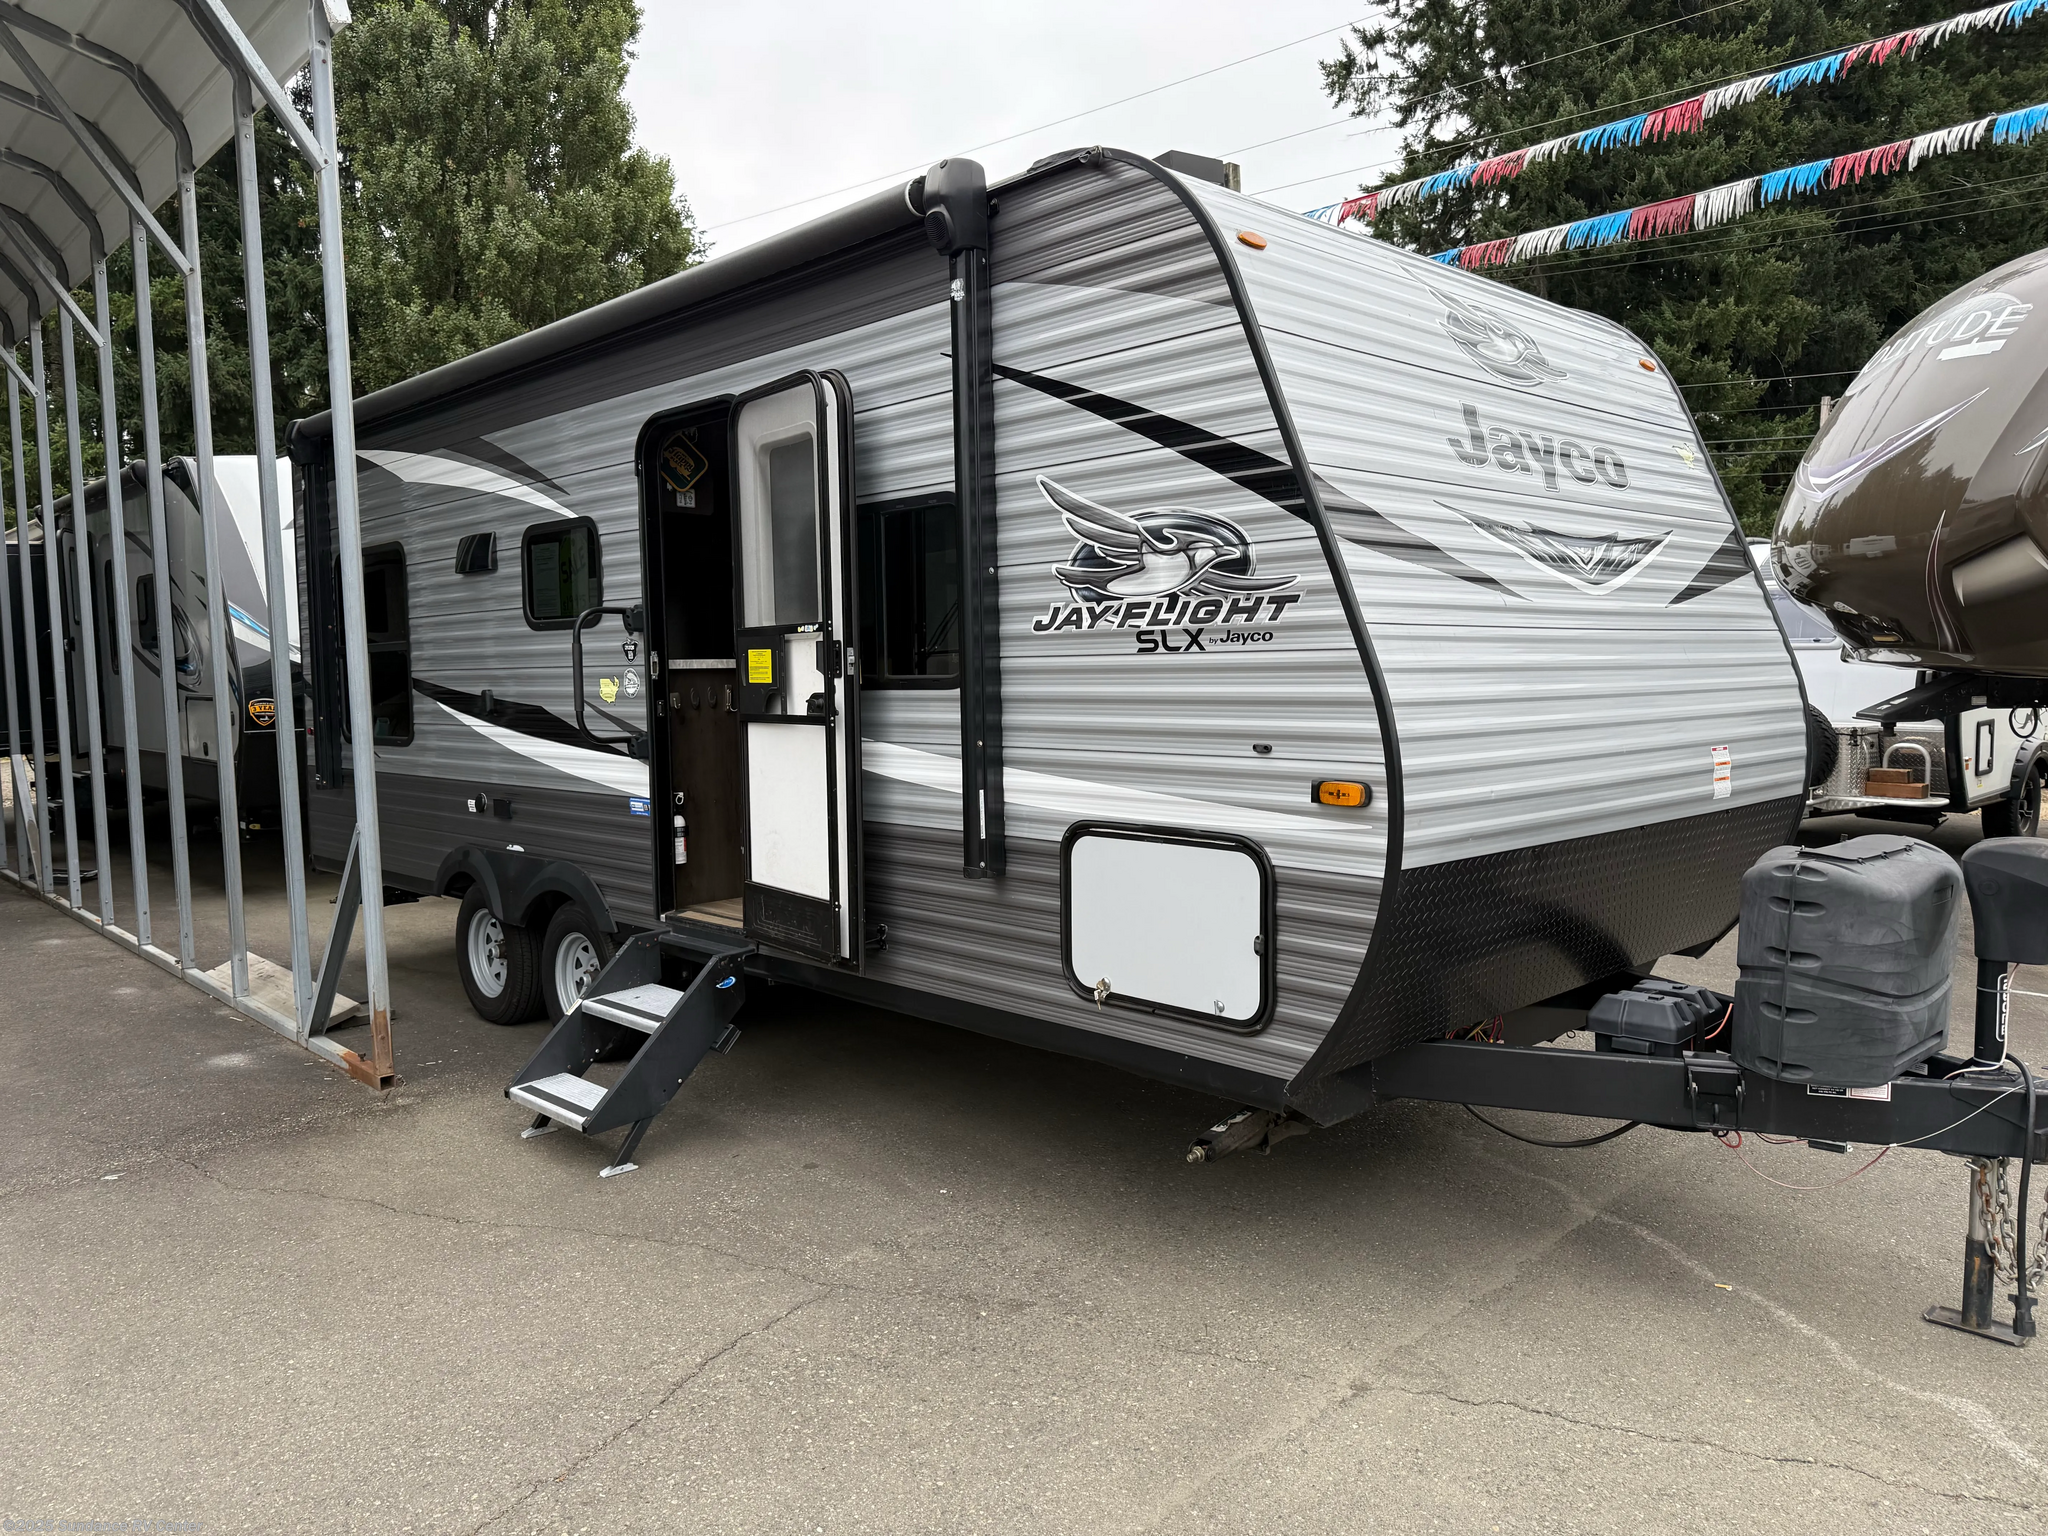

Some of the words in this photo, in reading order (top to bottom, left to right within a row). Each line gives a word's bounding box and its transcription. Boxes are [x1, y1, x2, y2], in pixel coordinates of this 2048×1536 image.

[1861, 303, 2034, 374] OLITUDE
[1446, 400, 1631, 492] Jayco
[1032, 603, 1118, 633] JAY
[1114, 592, 1302, 630] FLIGHT
[1136, 627, 1206, 653] SLX
[1209, 637, 1219, 645] by
[1219, 630, 1274, 646] Jayco
